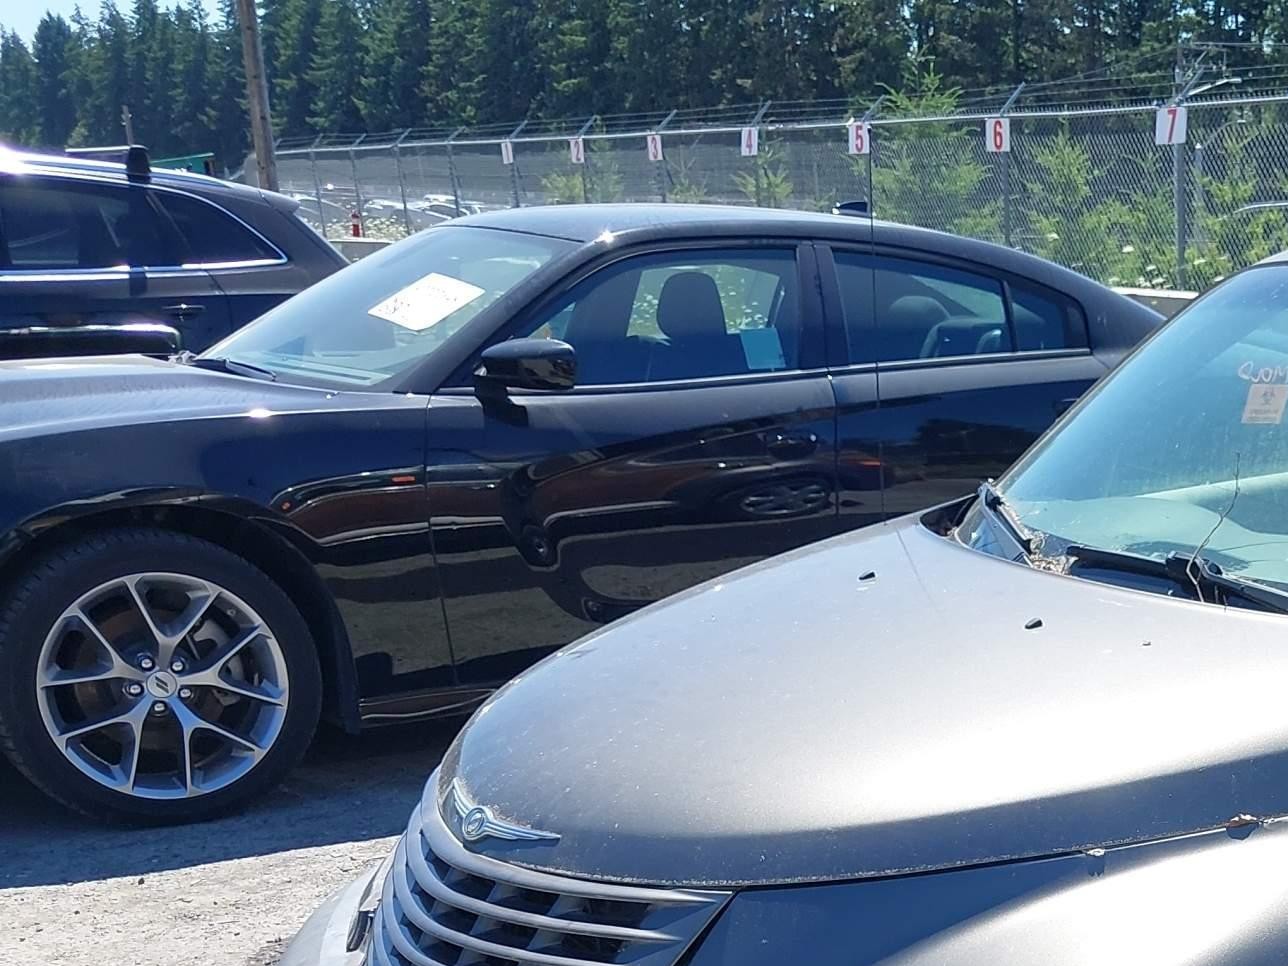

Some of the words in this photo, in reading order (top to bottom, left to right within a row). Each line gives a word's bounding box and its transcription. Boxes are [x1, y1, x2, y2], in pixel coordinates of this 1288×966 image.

[854, 125, 865, 153] 5
[993, 119, 1004, 150] 6
[1166, 108, 1178, 143] 7
[573, 140, 582, 162] 2
[650, 136, 659, 160] 3
[744, 128, 753, 155] 4
